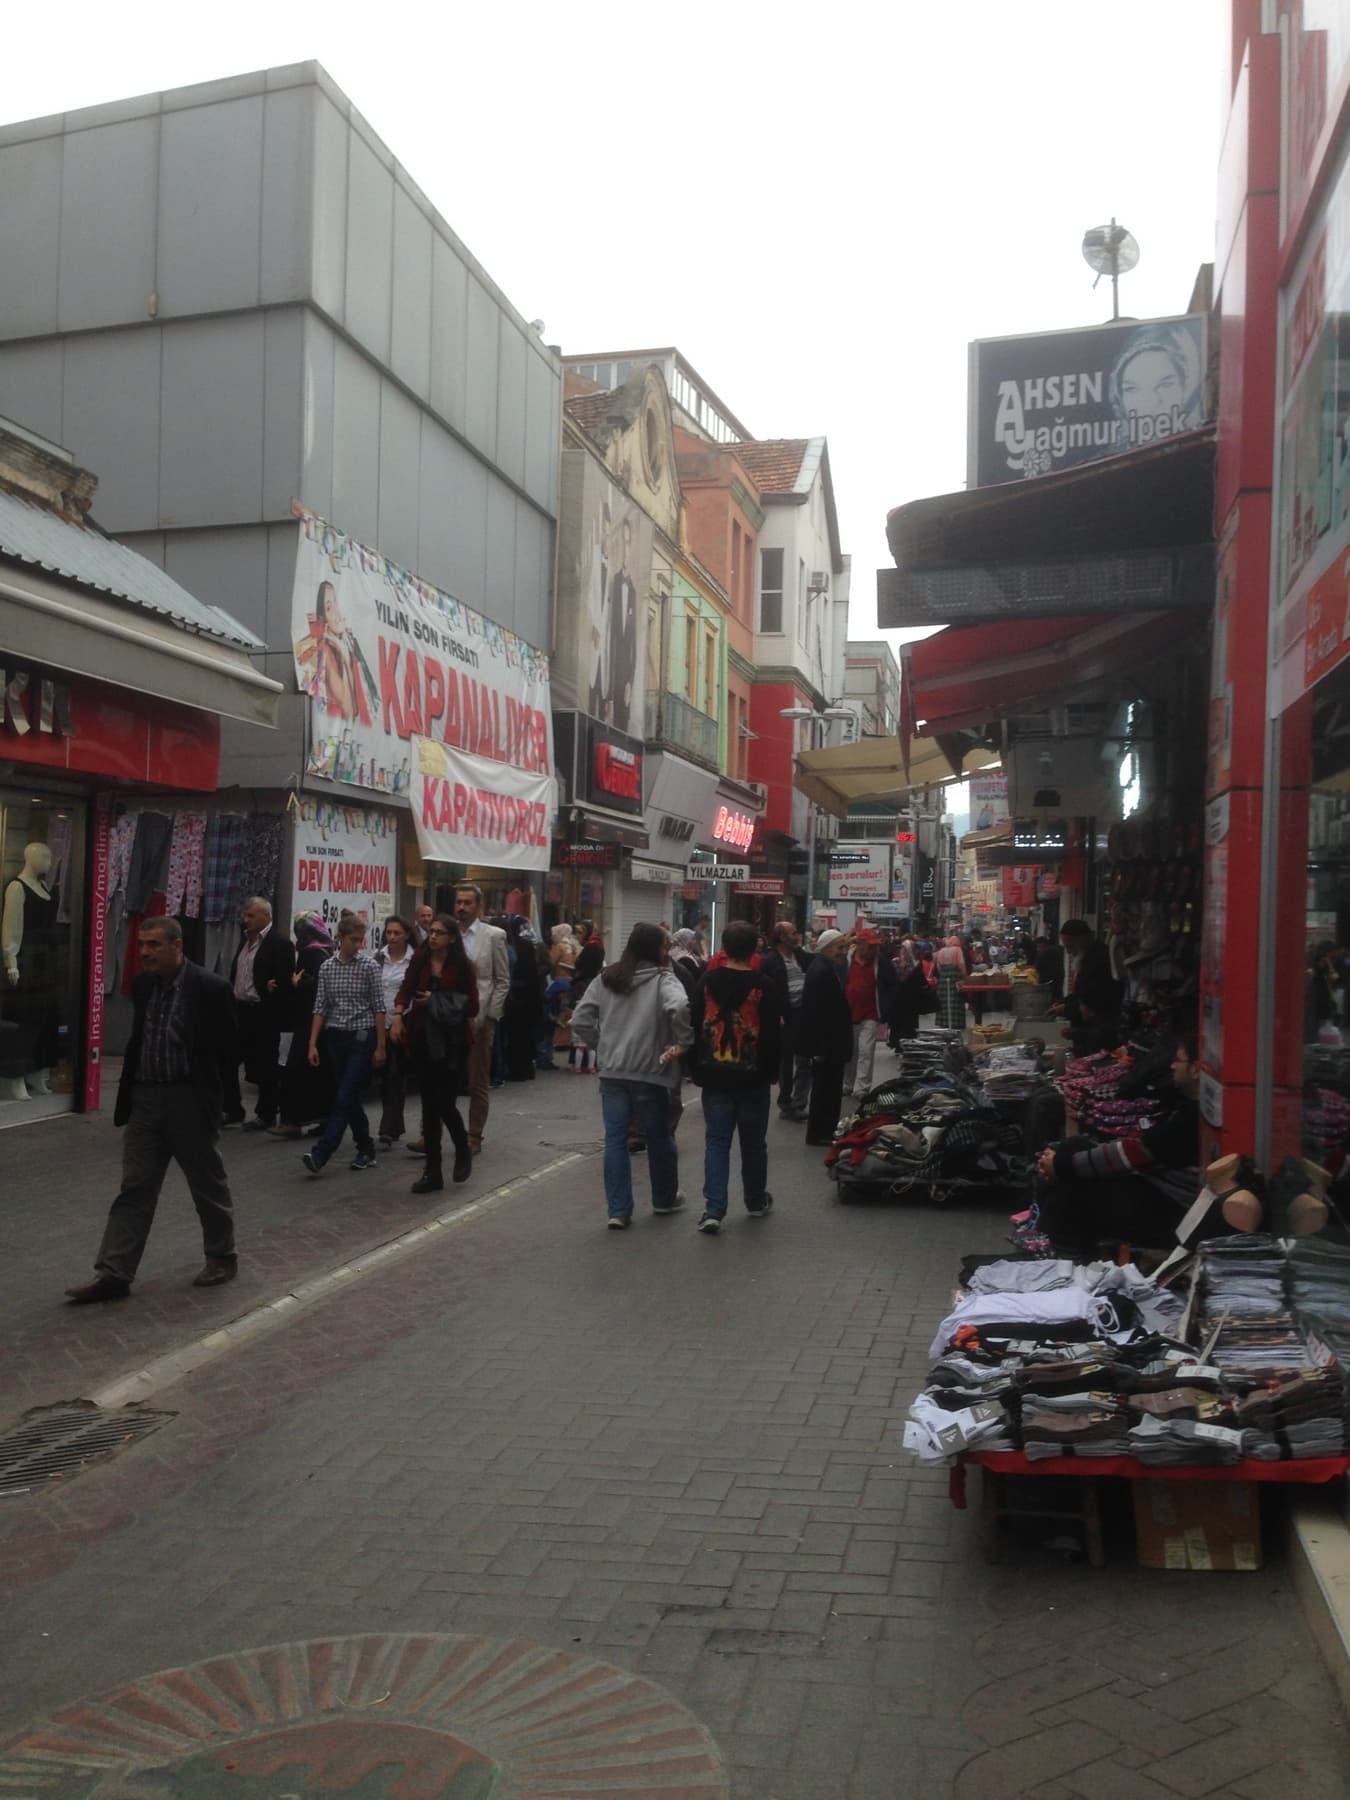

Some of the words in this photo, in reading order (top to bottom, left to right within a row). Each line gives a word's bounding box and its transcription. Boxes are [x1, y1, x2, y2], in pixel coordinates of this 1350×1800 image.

[995, 371, 1103, 442] AHSEN
[1129, 404, 1187, 445] ipek
[413, 618, 439, 649] SON
[442, 635, 480, 669] FIRSATI
[422, 776, 548, 848] KAPATIYORUZ
[298, 859, 326, 893] DEV
[328, 861, 391, 894] KAMPANYA
[690, 866, 744, 880] YILMAZLAR
